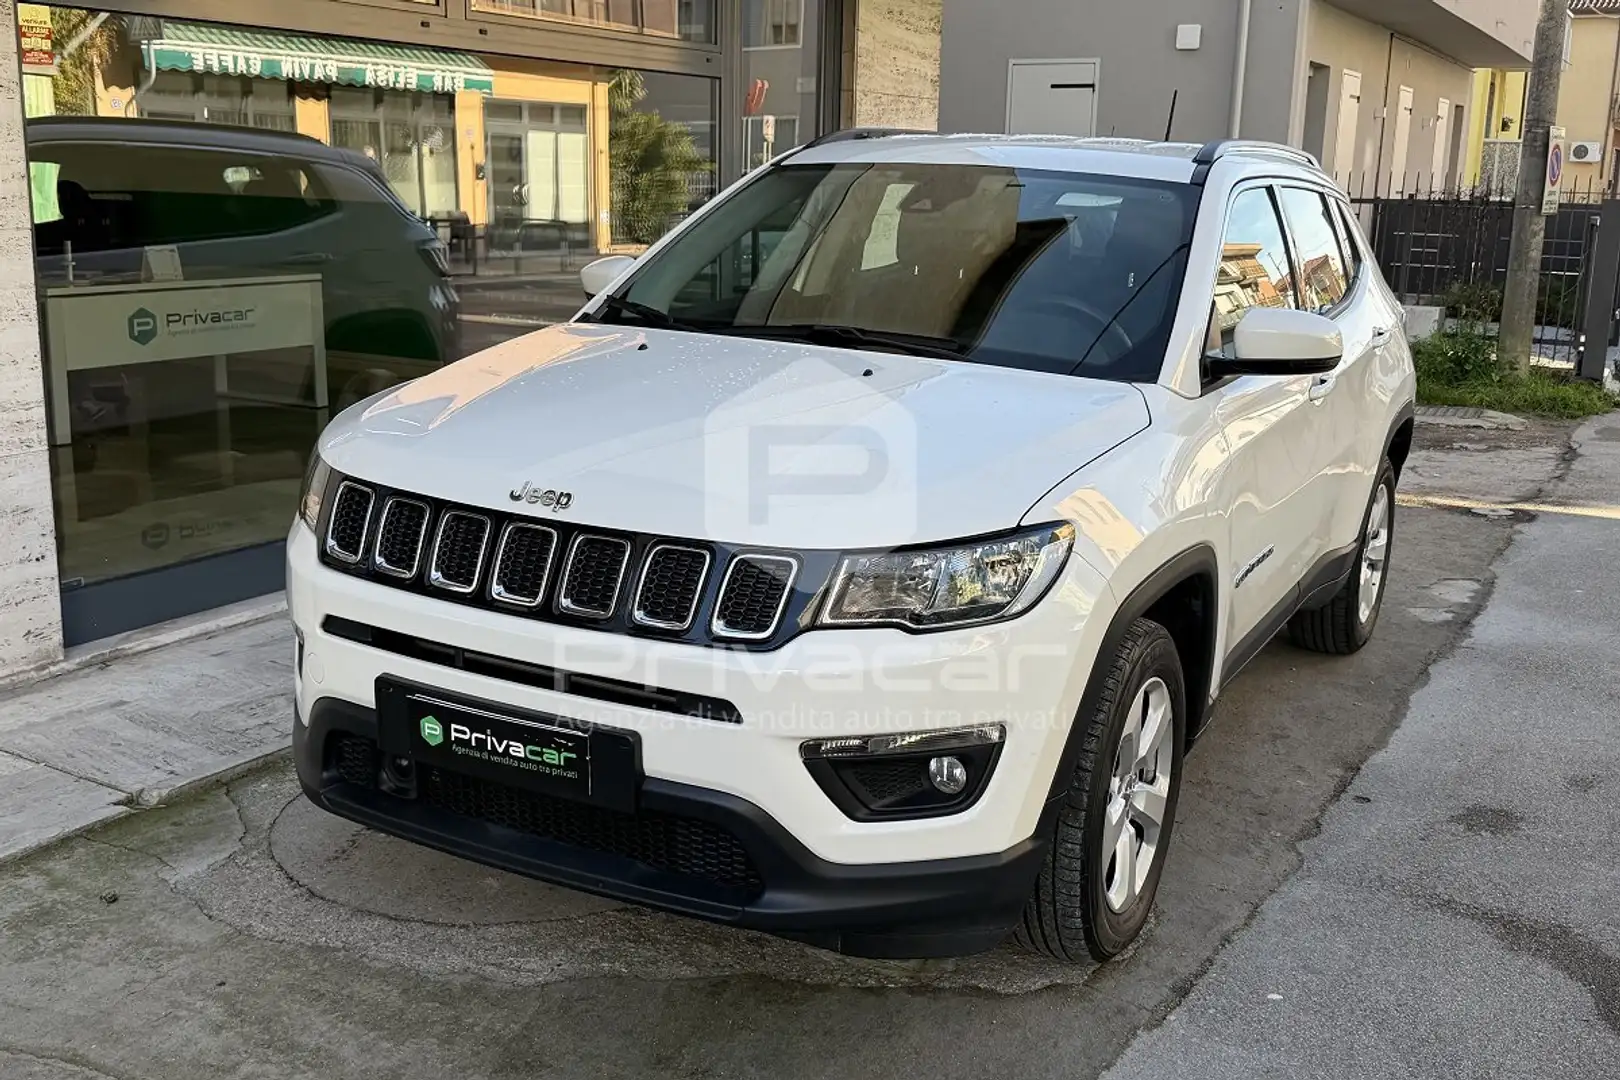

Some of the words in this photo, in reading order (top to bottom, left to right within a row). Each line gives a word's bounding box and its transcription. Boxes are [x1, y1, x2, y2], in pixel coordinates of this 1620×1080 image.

[166, 308, 255, 327] Privacar
[509, 480, 574, 513] Jeep
[450, 723, 577, 766] Privacar
[452, 743, 481, 760] Agenzia
[481, 751, 489, 761] di
[490, 753, 519, 768] vendita
[519, 760, 538, 772] auto
[539, 764, 551, 774] tra
[552, 766, 578, 780] privati
